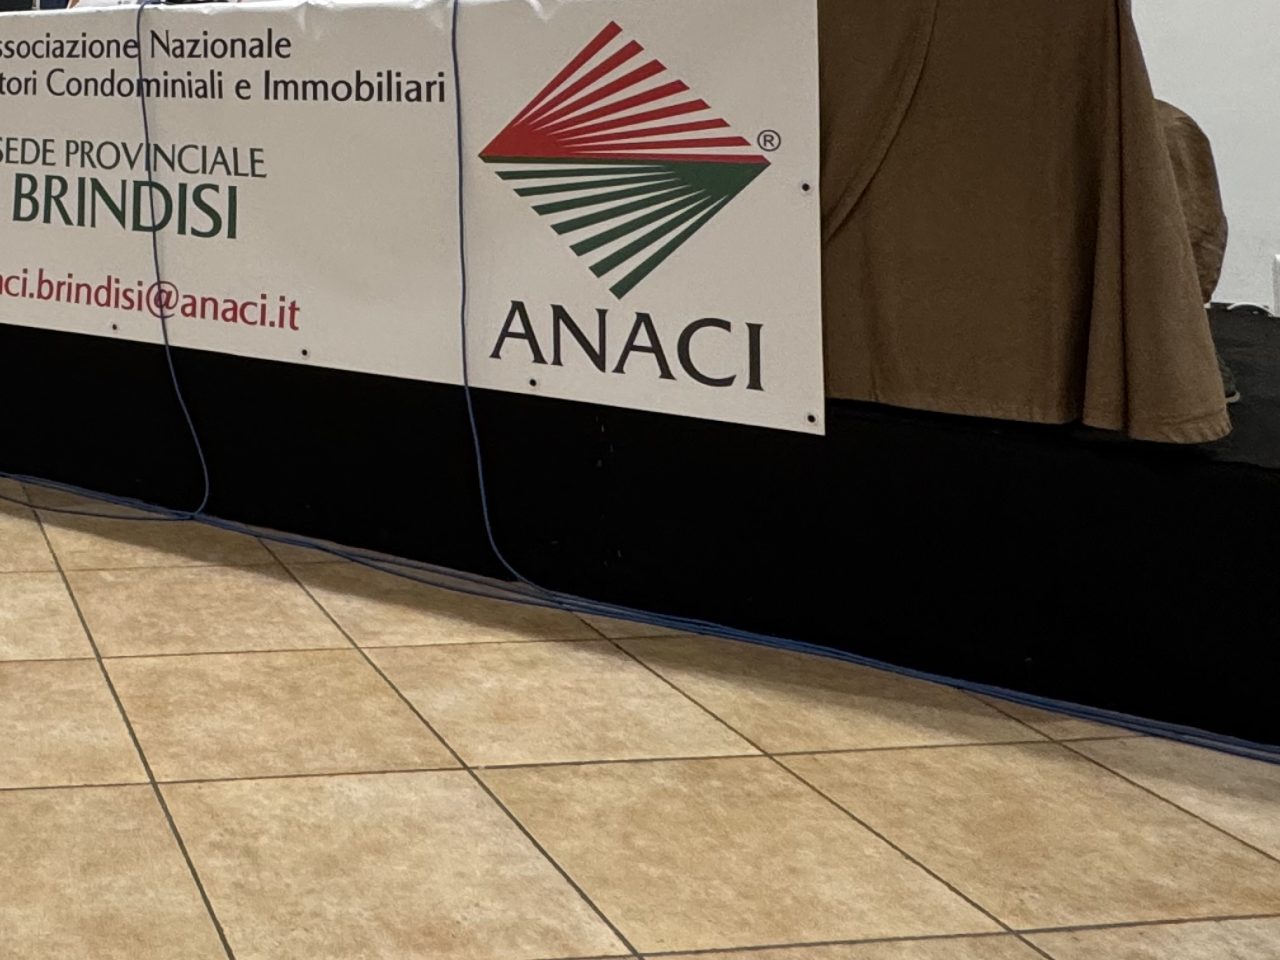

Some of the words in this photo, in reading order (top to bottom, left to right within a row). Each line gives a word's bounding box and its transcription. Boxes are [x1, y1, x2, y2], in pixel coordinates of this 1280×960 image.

[150, 28, 292, 58] Nazionale
[46, 68, 225, 100] Condominiali
[235, 81, 253, 101] e
[263, 70, 447, 103] Immobiliari
[65, 140, 267, 178] PROVINCIALE
[12, 173, 239, 239] BRINDISI
[489, 300, 764, 391] ANACI
